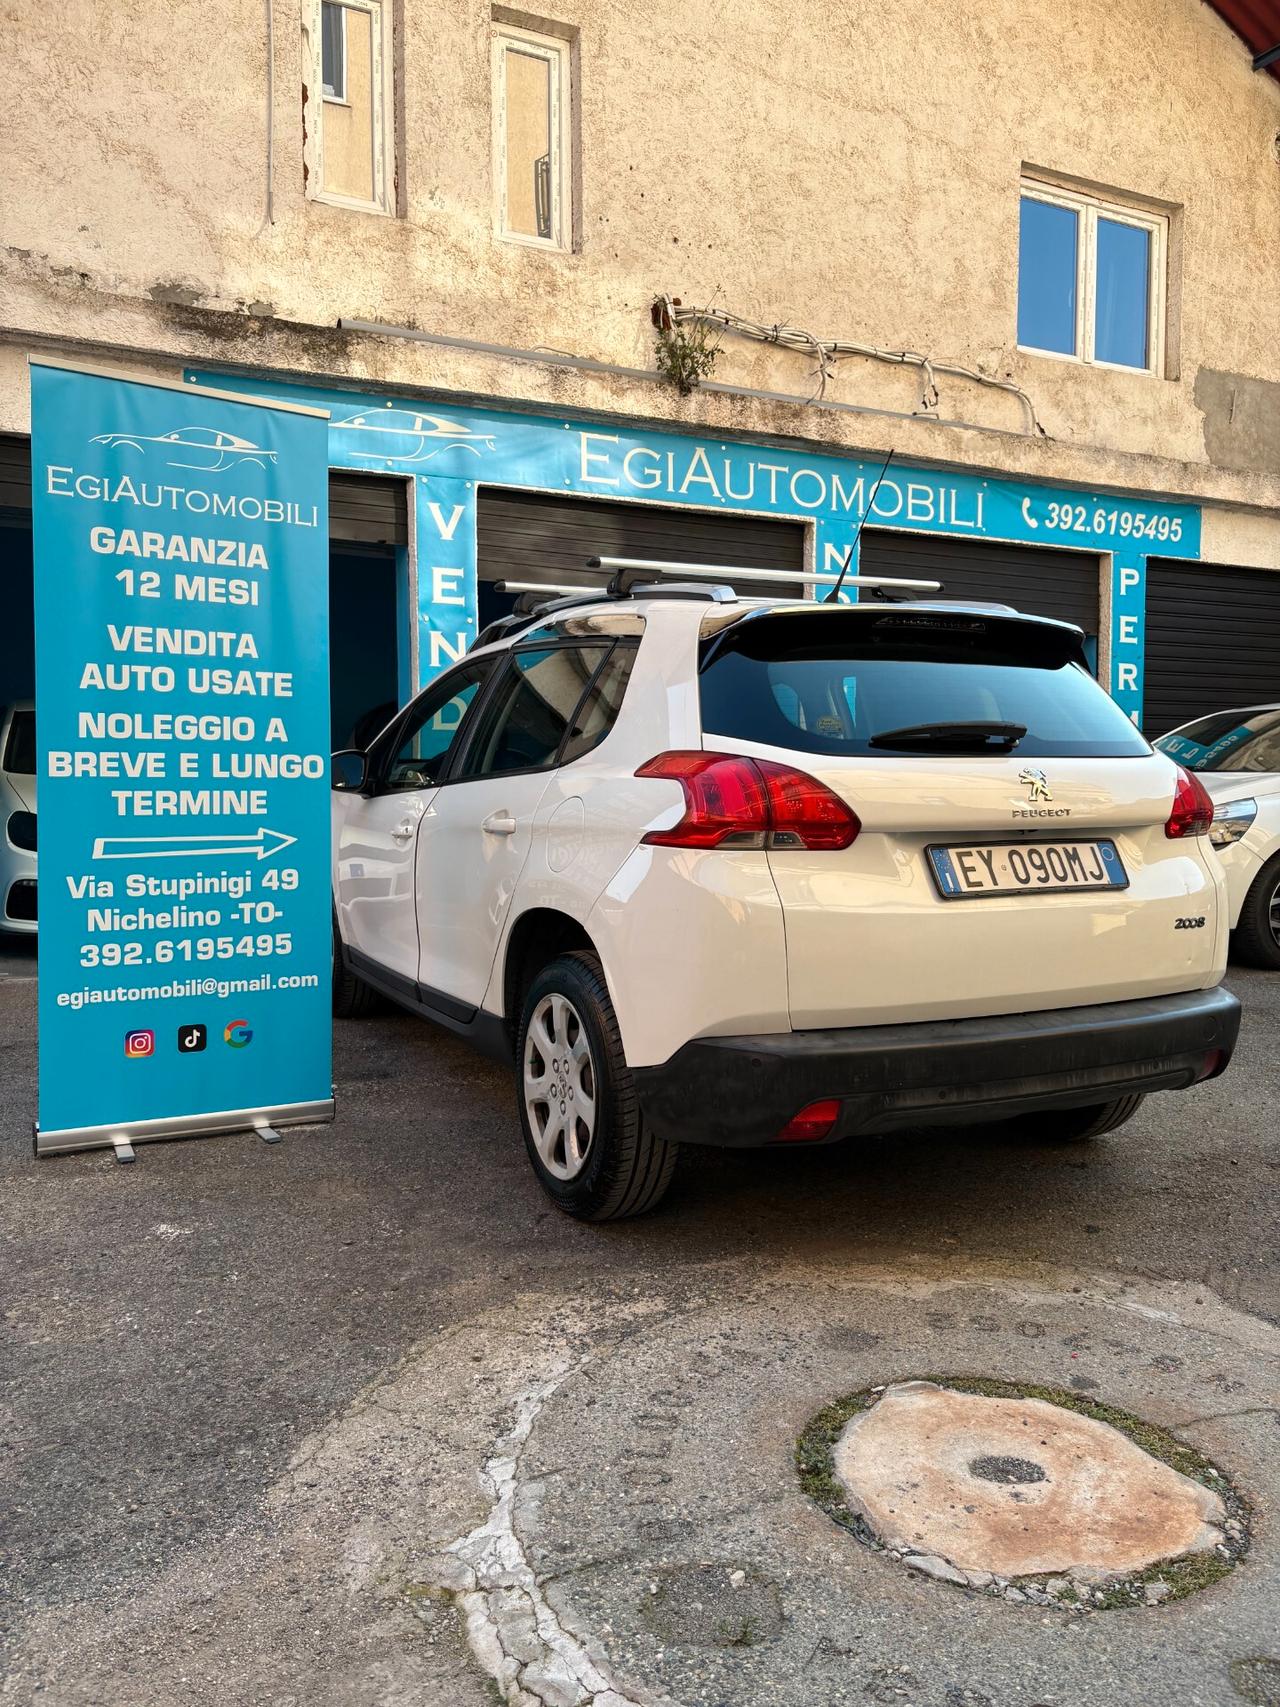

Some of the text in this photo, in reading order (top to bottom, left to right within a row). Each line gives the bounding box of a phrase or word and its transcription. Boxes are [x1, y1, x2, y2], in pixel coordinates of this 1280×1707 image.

[1044, 502, 1183, 543] 392.6195495
[90, 526, 270, 570] GARANZIA
[115, 569, 259, 606] 12 MESI
[107, 624, 259, 659] VENDITA
[79, 663, 293, 697] AUTO USATE
[78, 712, 289, 742] NOLEGGIO A
[48, 751, 324, 779] BREVE E LUNGO
[111, 790, 268, 816] TERMINE
[1011, 808, 1071, 818] PEUGEOT
[66, 868, 299, 900] Via Stupinigi 49
[955, 850, 998, 888] EY
[1008, 846, 1104, 885] 090MJ
[87, 901, 283, 932] Nichelino -TO-
[1174, 916, 1206, 929] 2008
[80, 933, 292, 967] 392.6195495
[57, 973, 318, 1009] egiautomobili@gmail.com
